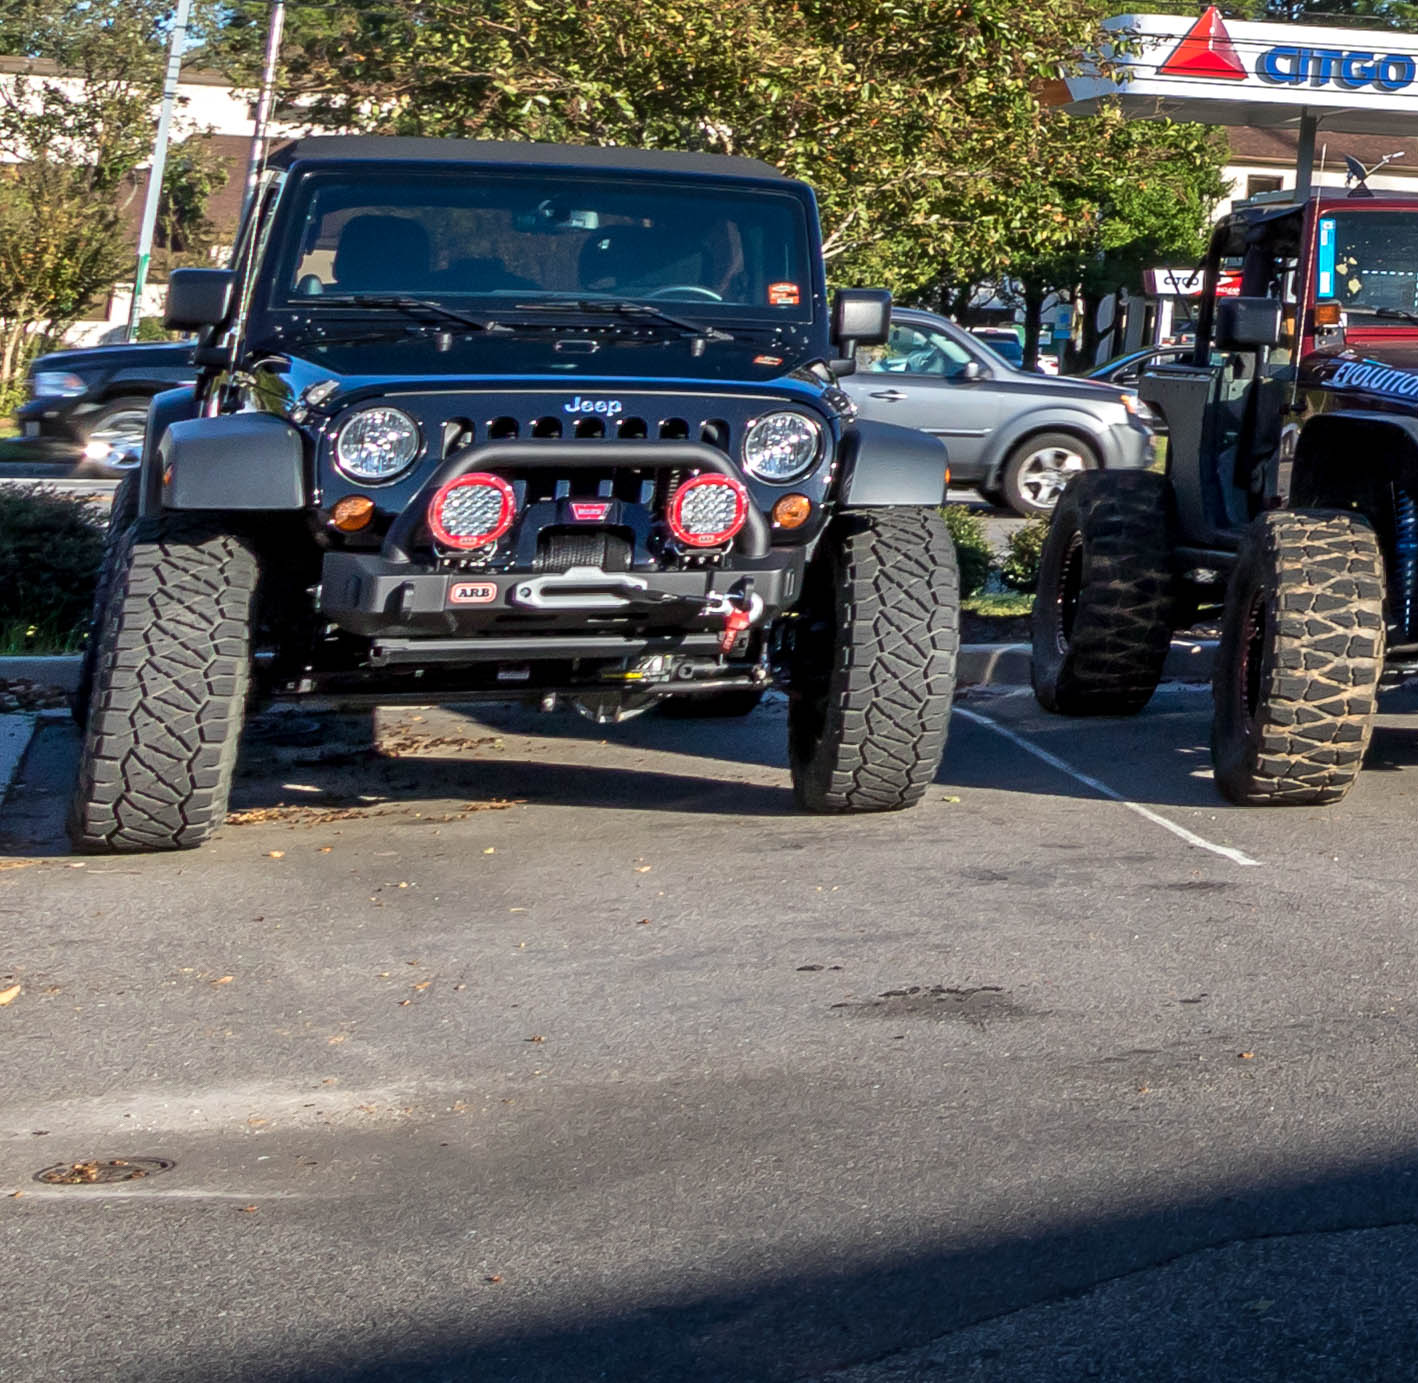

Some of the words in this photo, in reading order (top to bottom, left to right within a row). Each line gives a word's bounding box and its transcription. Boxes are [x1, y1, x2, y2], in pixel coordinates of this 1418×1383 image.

[1256, 46, 1416, 92] CITGO
[564, 396, 622, 417] Jeep
[457, 587, 491, 598] ARB
